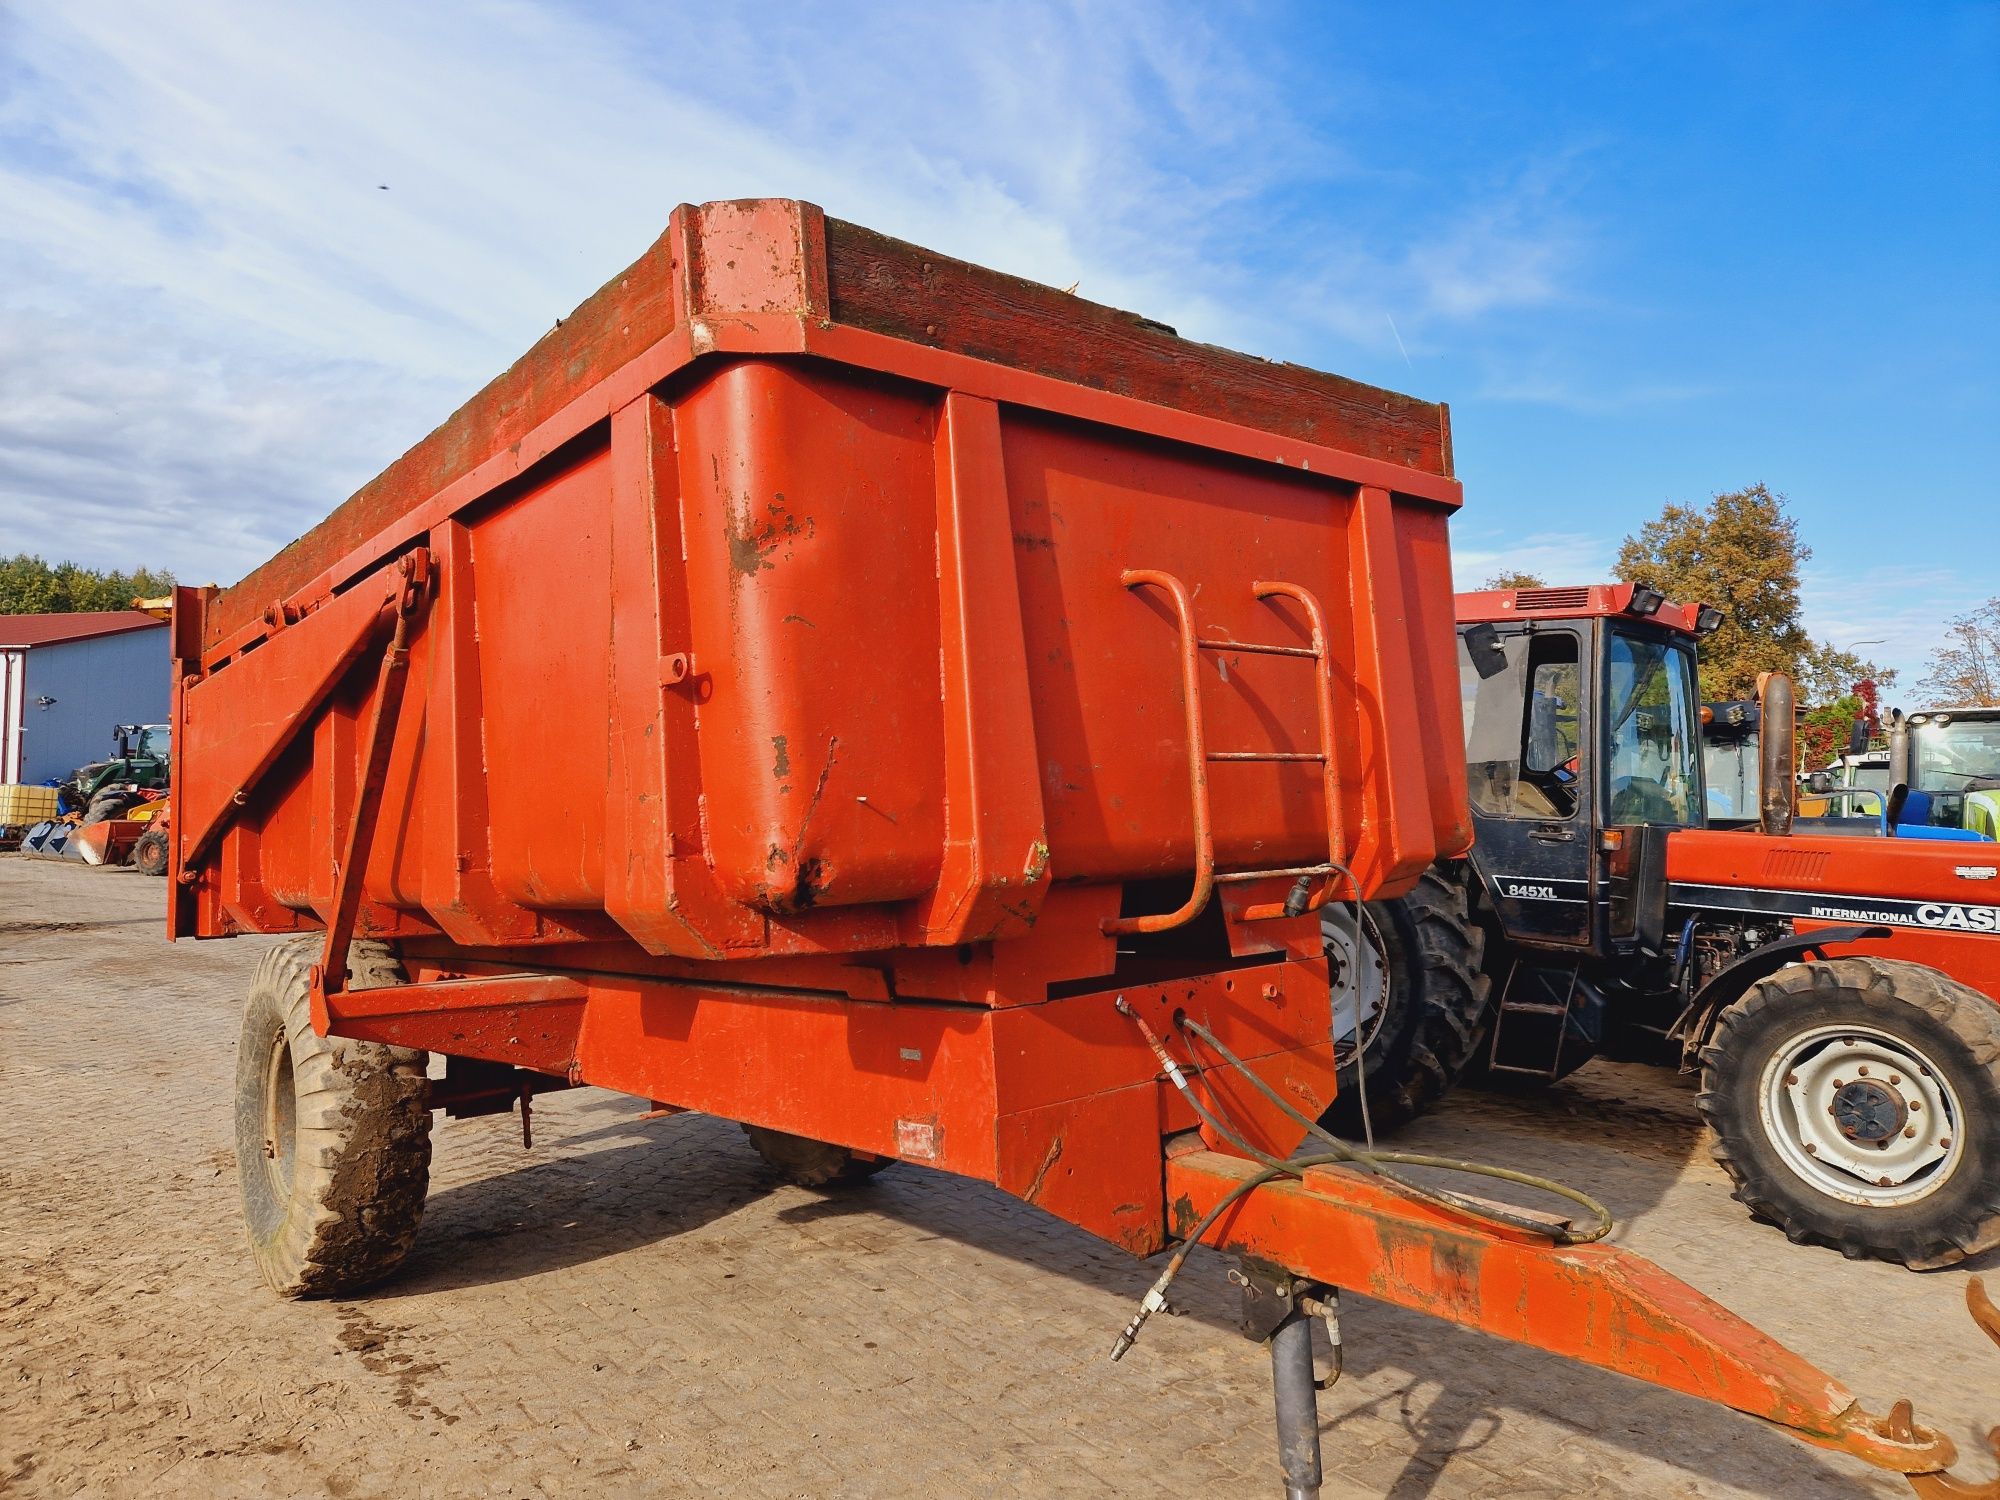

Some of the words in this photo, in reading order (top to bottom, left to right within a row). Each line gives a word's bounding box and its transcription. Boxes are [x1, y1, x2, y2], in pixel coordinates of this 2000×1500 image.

[1508, 884, 1558, 899] 845XL
[1811, 906, 1917, 924] INTERNATIONAL
[1917, 904, 2000, 931] CAS
